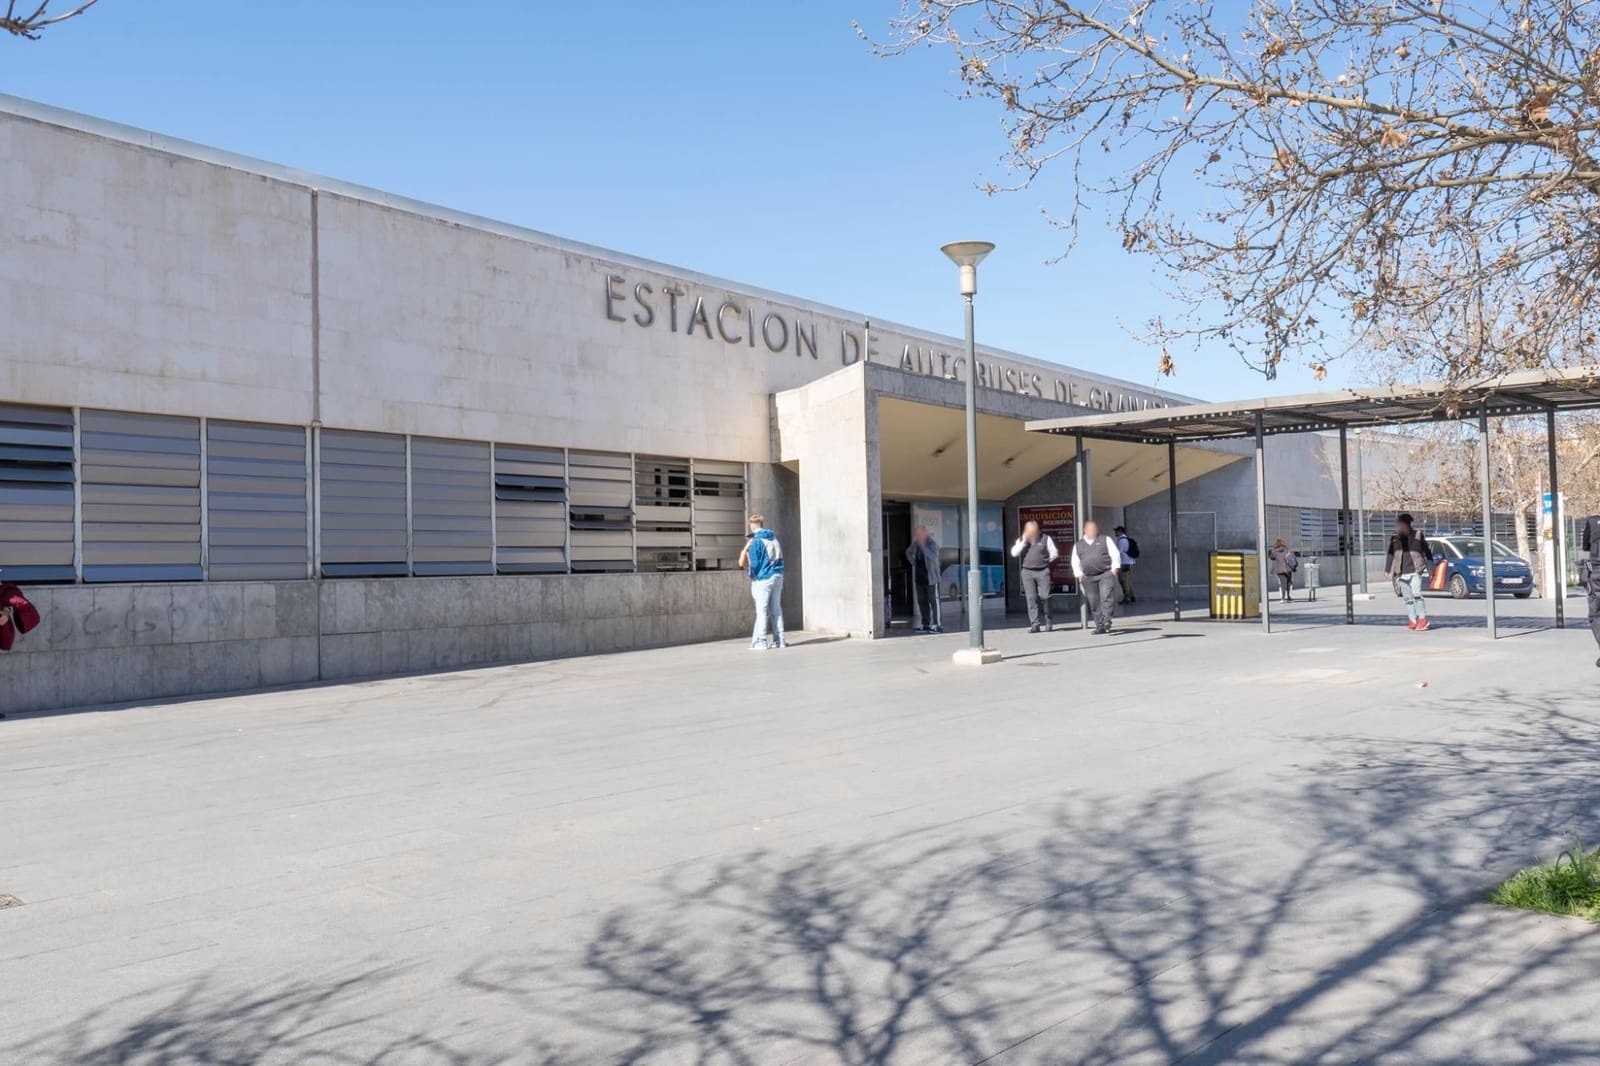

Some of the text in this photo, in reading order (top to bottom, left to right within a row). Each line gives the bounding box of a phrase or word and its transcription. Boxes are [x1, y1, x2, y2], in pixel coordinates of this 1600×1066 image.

[605, 274, 819, 361] ESTACION
[841, 329, 880, 366] DE
[1055, 379, 1078, 404] DE
